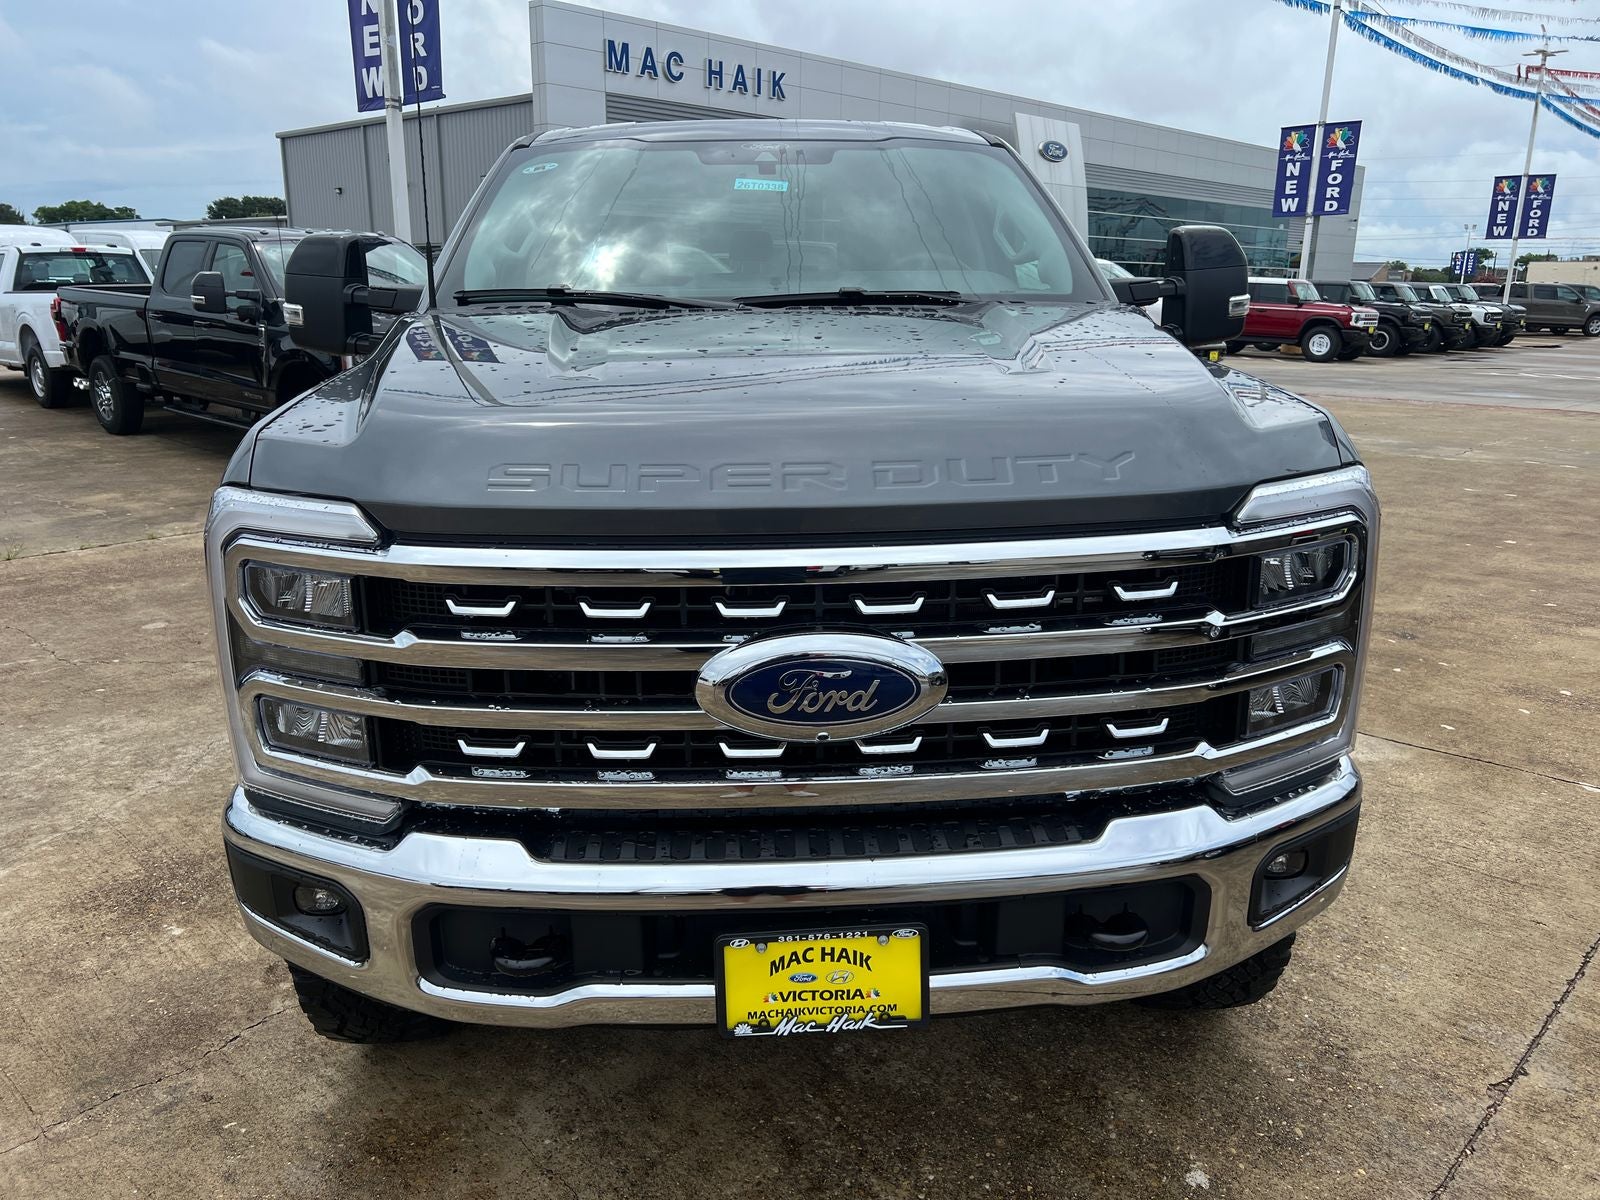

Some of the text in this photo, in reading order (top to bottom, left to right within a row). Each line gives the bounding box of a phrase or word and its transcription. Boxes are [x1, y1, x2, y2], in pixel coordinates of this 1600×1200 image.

[605, 39, 786, 100] MAC HAIK
[1281, 162, 1301, 212] NEW
[1324, 160, 1343, 212] FORD
[1493, 200, 1510, 236] NEW
[1526, 200, 1543, 236] FORD
[486, 450, 1137, 492] SUPER DUTY
[767, 669, 881, 714] Ford
[778, 931, 868, 942] 361-576-1221
[769, 947, 873, 977] MAC HAIK
[747, 1004, 897, 1020] MACHAIKVICTORIA.COM
[778, 988, 865, 1002] VICTORIA
[770, 1012, 881, 1036] Mac Haik
